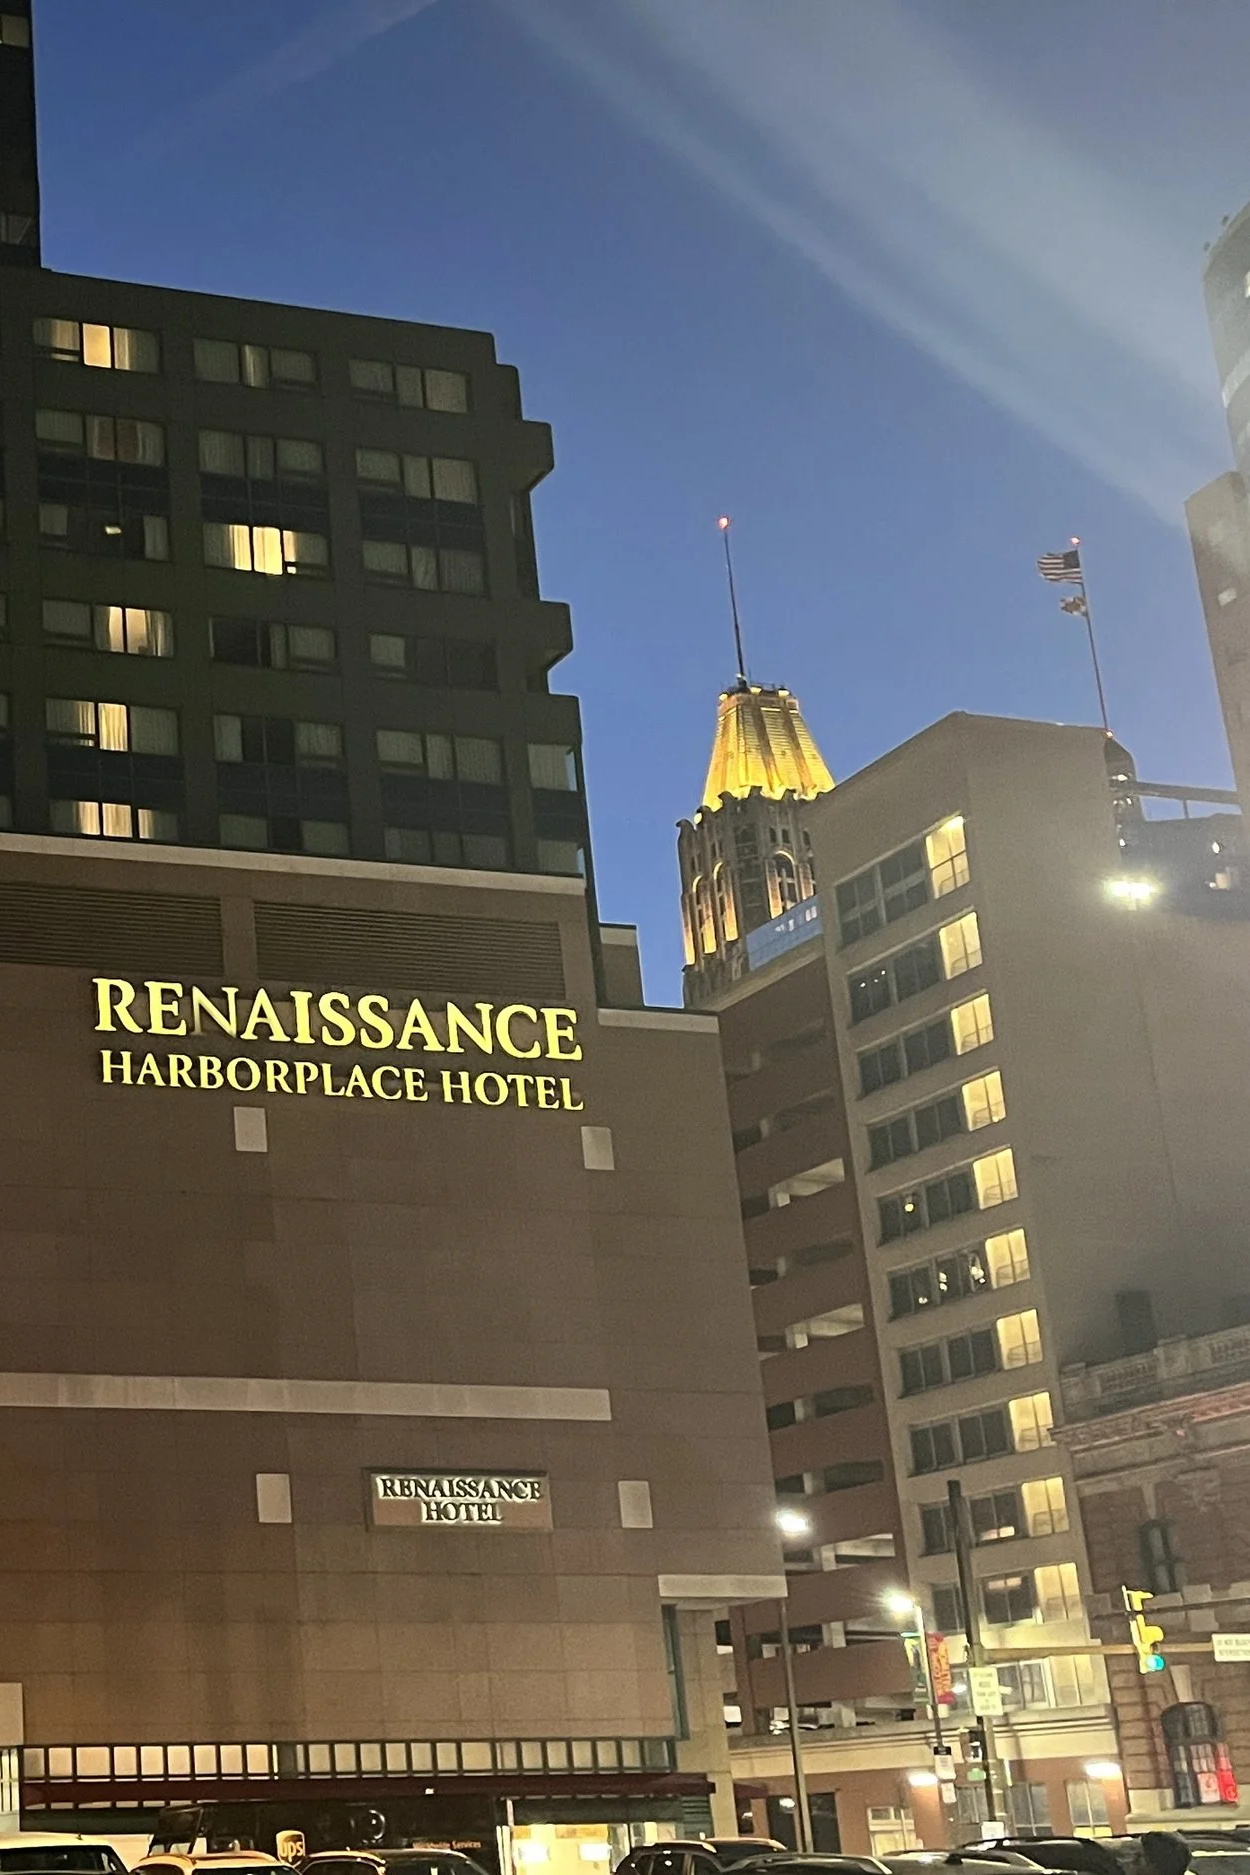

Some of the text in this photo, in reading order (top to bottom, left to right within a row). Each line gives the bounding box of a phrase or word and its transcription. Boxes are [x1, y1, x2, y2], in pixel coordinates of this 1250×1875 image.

[92, 977, 583, 1061] RENAISSANCE
[100, 1049, 584, 1111] HARBORPLACE HOTEL
[379, 1477, 543, 1501] RENAISSANCE
[423, 1500, 502, 1522] HOTEL
[280, 1841, 304, 1862] ups
